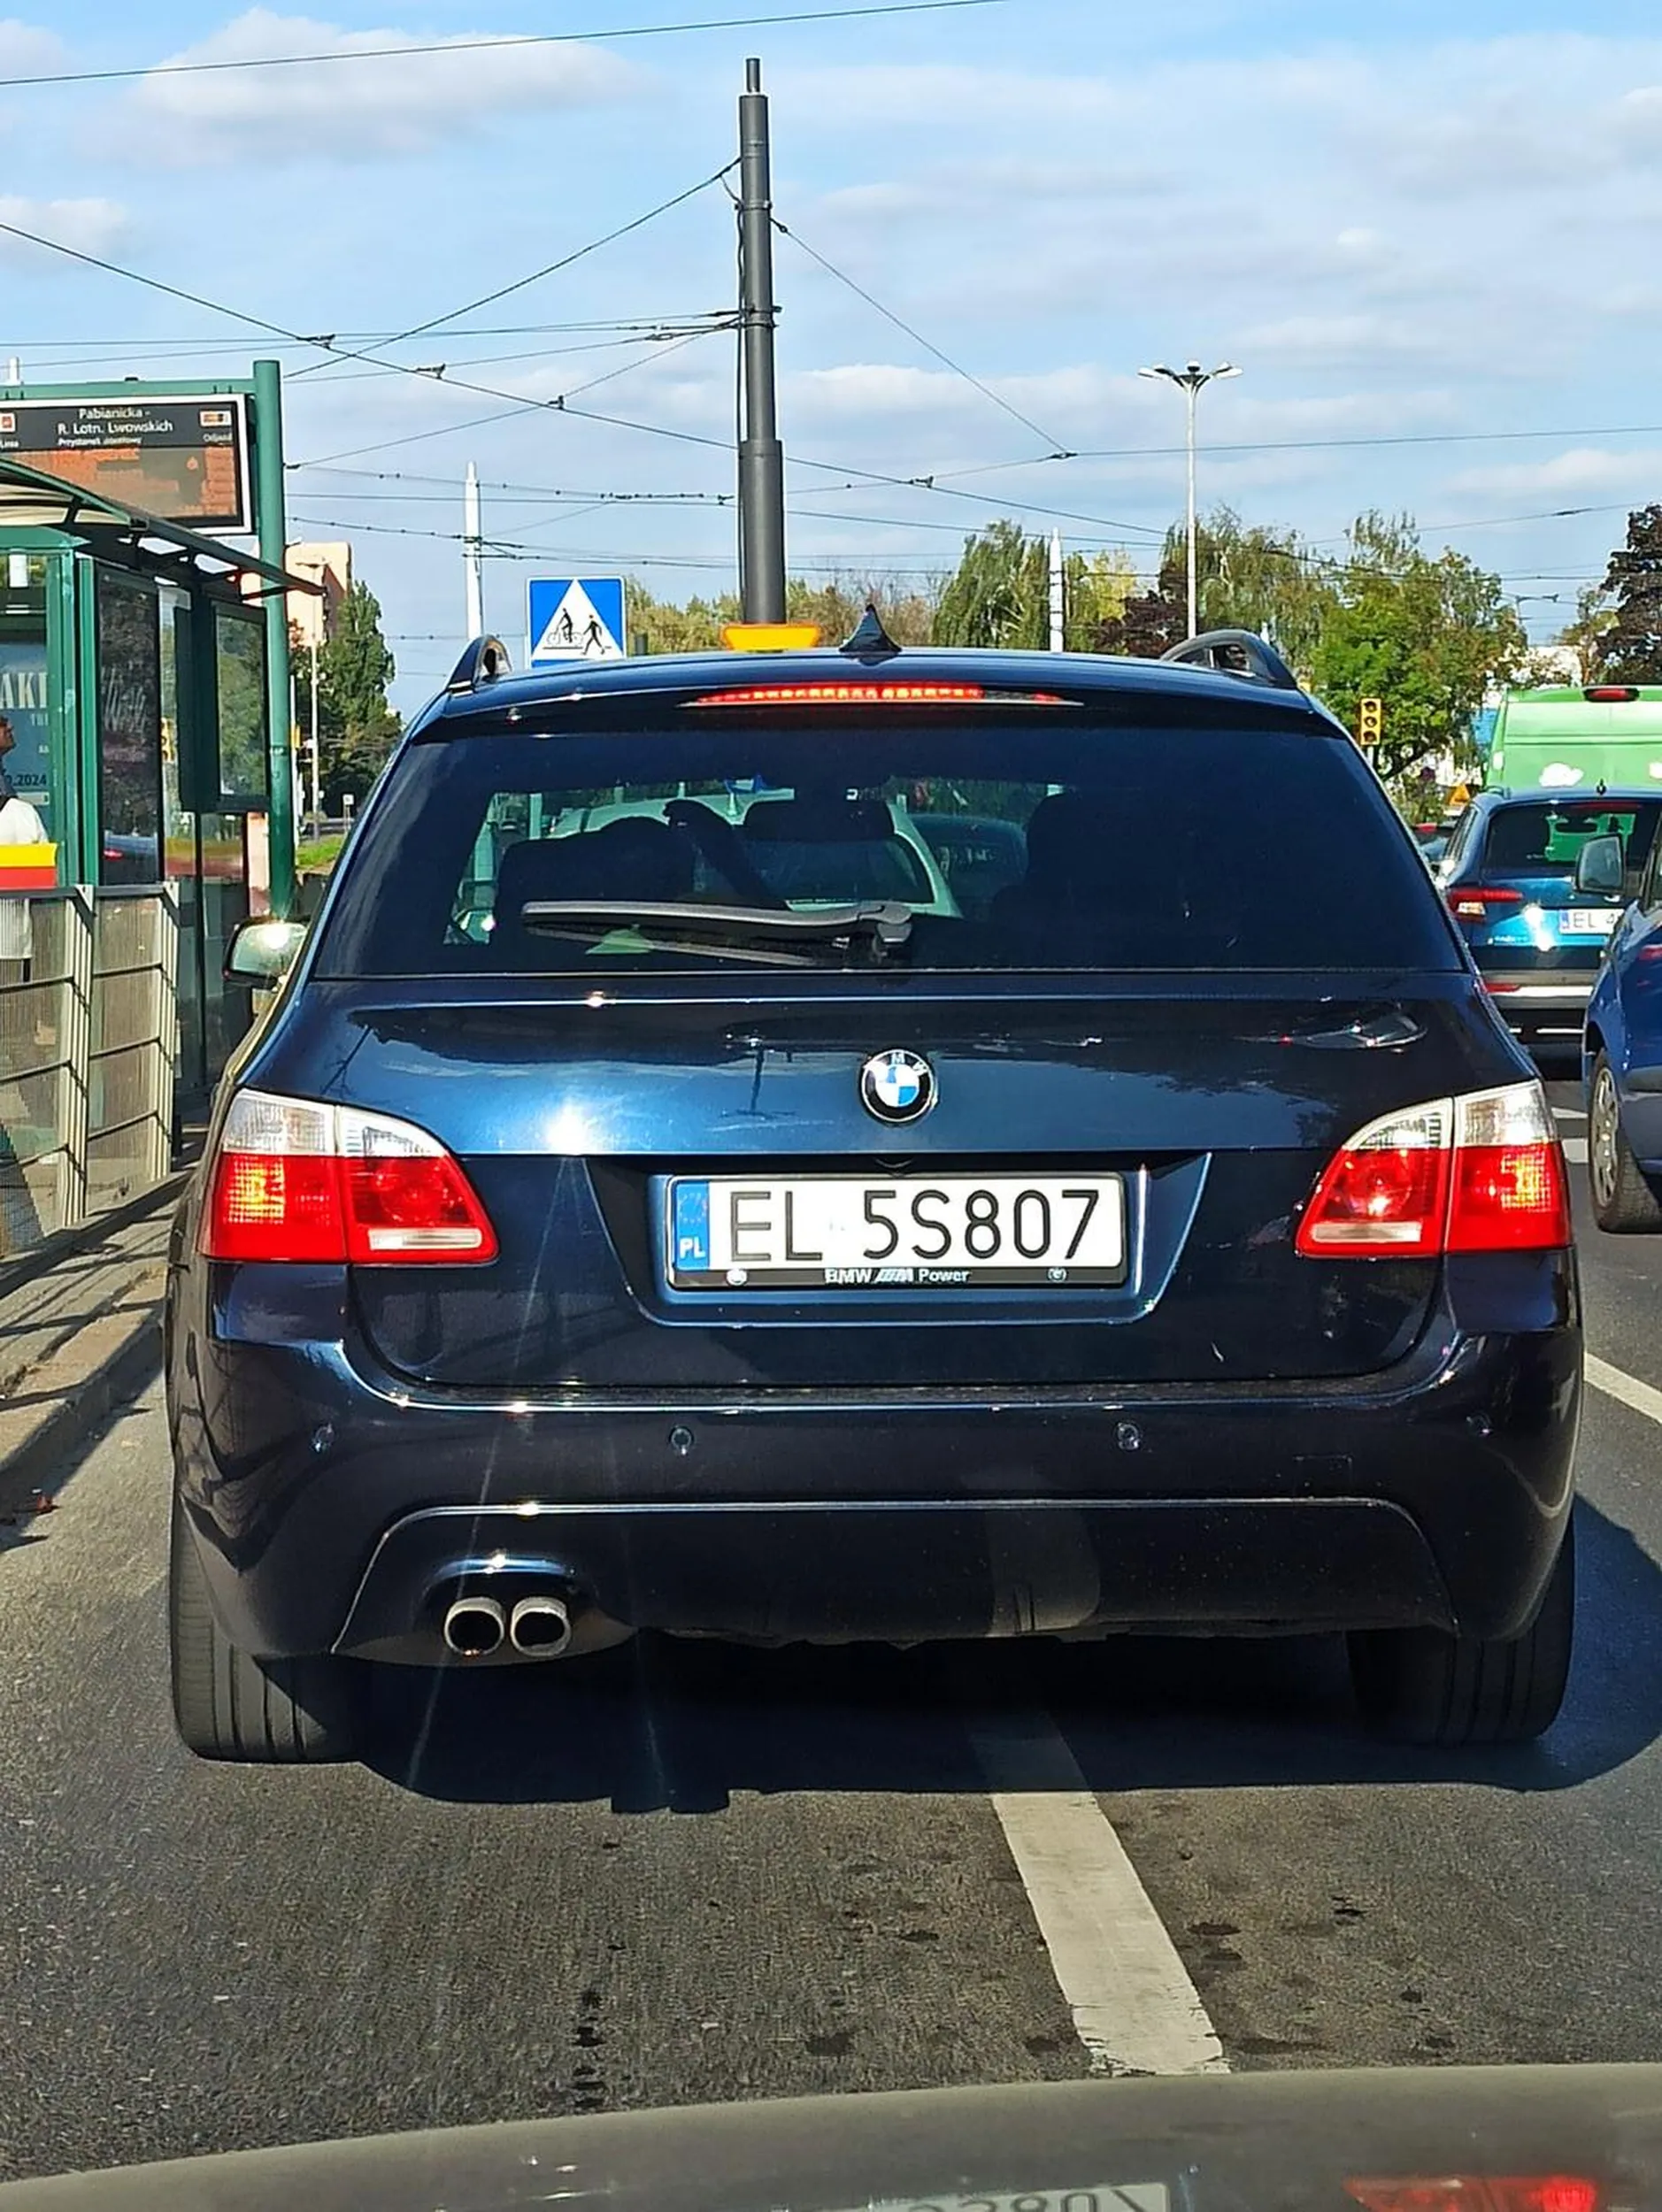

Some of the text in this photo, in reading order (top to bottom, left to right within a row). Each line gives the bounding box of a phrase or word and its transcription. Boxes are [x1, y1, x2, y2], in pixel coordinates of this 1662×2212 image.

[78, 407, 142, 419] Pabianicka
[57, 419, 173, 434] R. Lotn. Lwowskich
[1573, 911, 1598, 929] EL
[729, 1188, 1101, 1263] EL 5S807
[679, 1236, 706, 1260] PL
[824, 1268, 873, 1284] BMW
[918, 1268, 971, 1283] Power
